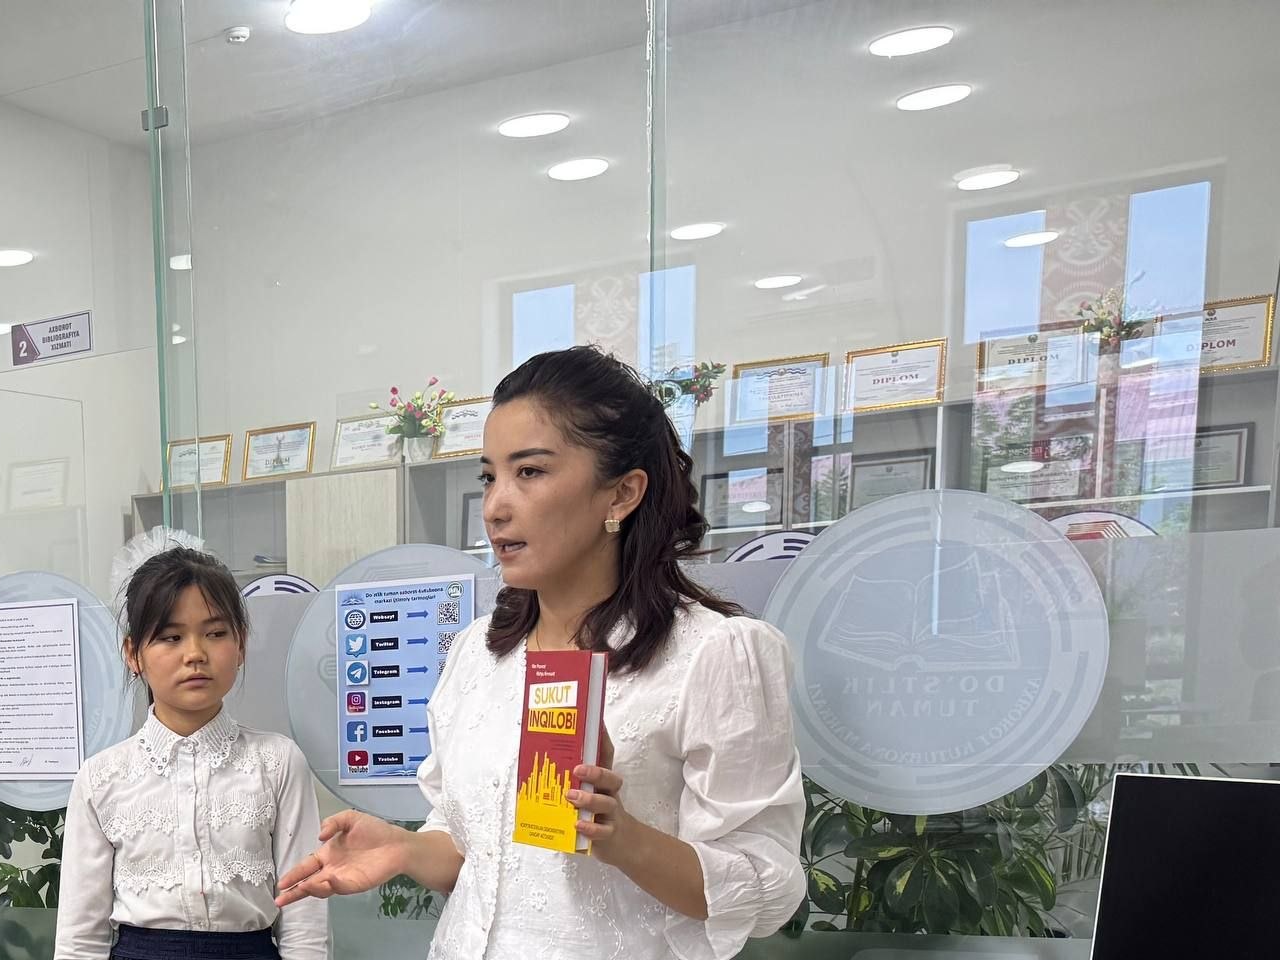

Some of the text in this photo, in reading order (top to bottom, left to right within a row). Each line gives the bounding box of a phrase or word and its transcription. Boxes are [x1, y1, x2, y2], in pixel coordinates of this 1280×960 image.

[49, 323, 71, 333] AXBOROT
[42, 331, 79, 343] BIBLIOGRAFIYA
[19, 340, 28, 357] 2
[51, 341, 71, 350] XIZMATI
[1186, 339, 1236, 352] DIPLOM
[1008, 353, 1059, 365] DIPLOM
[872, 373, 920, 386] DIPLOM
[534, 685, 571, 705] SUKUT
[529, 709, 576, 730] INQILOBI
